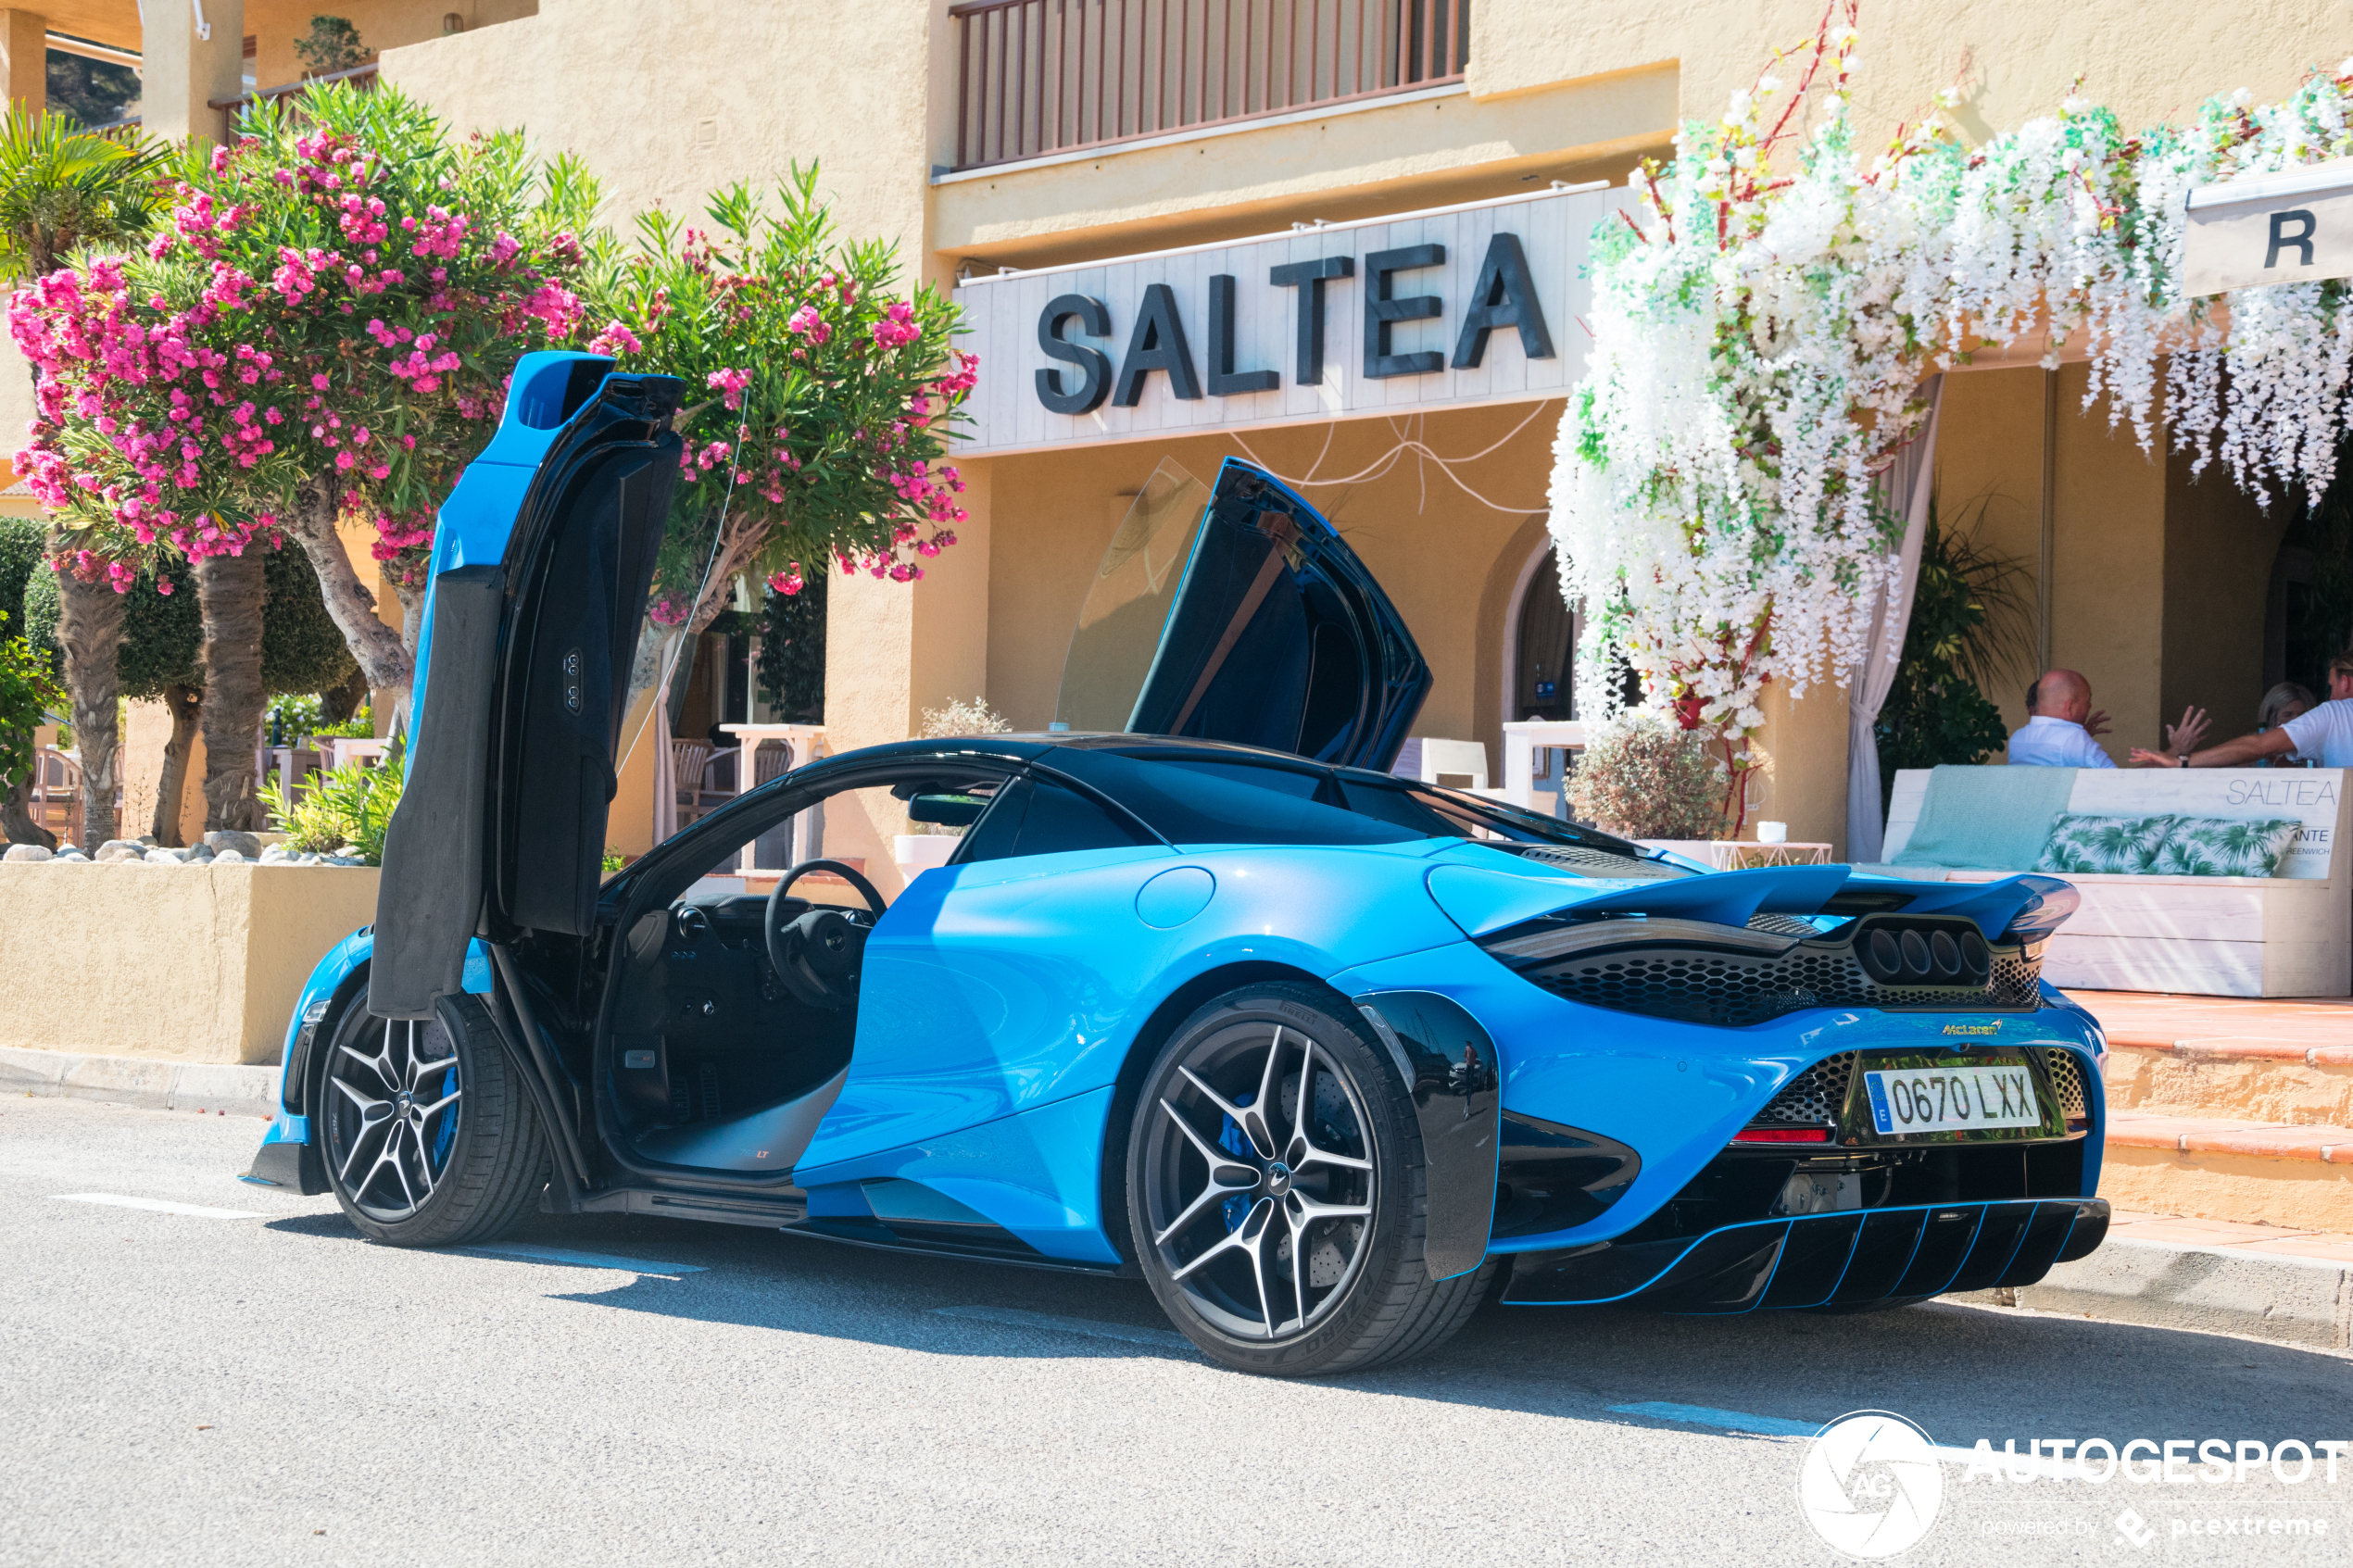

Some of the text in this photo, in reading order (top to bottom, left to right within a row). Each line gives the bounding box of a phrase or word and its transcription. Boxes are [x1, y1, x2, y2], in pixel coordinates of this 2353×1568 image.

[2263, 208, 2317, 270] R
[1035, 231, 1557, 416] SALTEA
[2226, 779, 2336, 806] SALTEA
[1278, 1000, 1318, 1026] PIRELLI
[1940, 1024, 1998, 1035] McLaren
[1892, 1075, 1971, 1124] 0670
[1974, 1073, 2033, 1119] LXX
[1879, 1109, 1887, 1122] E
